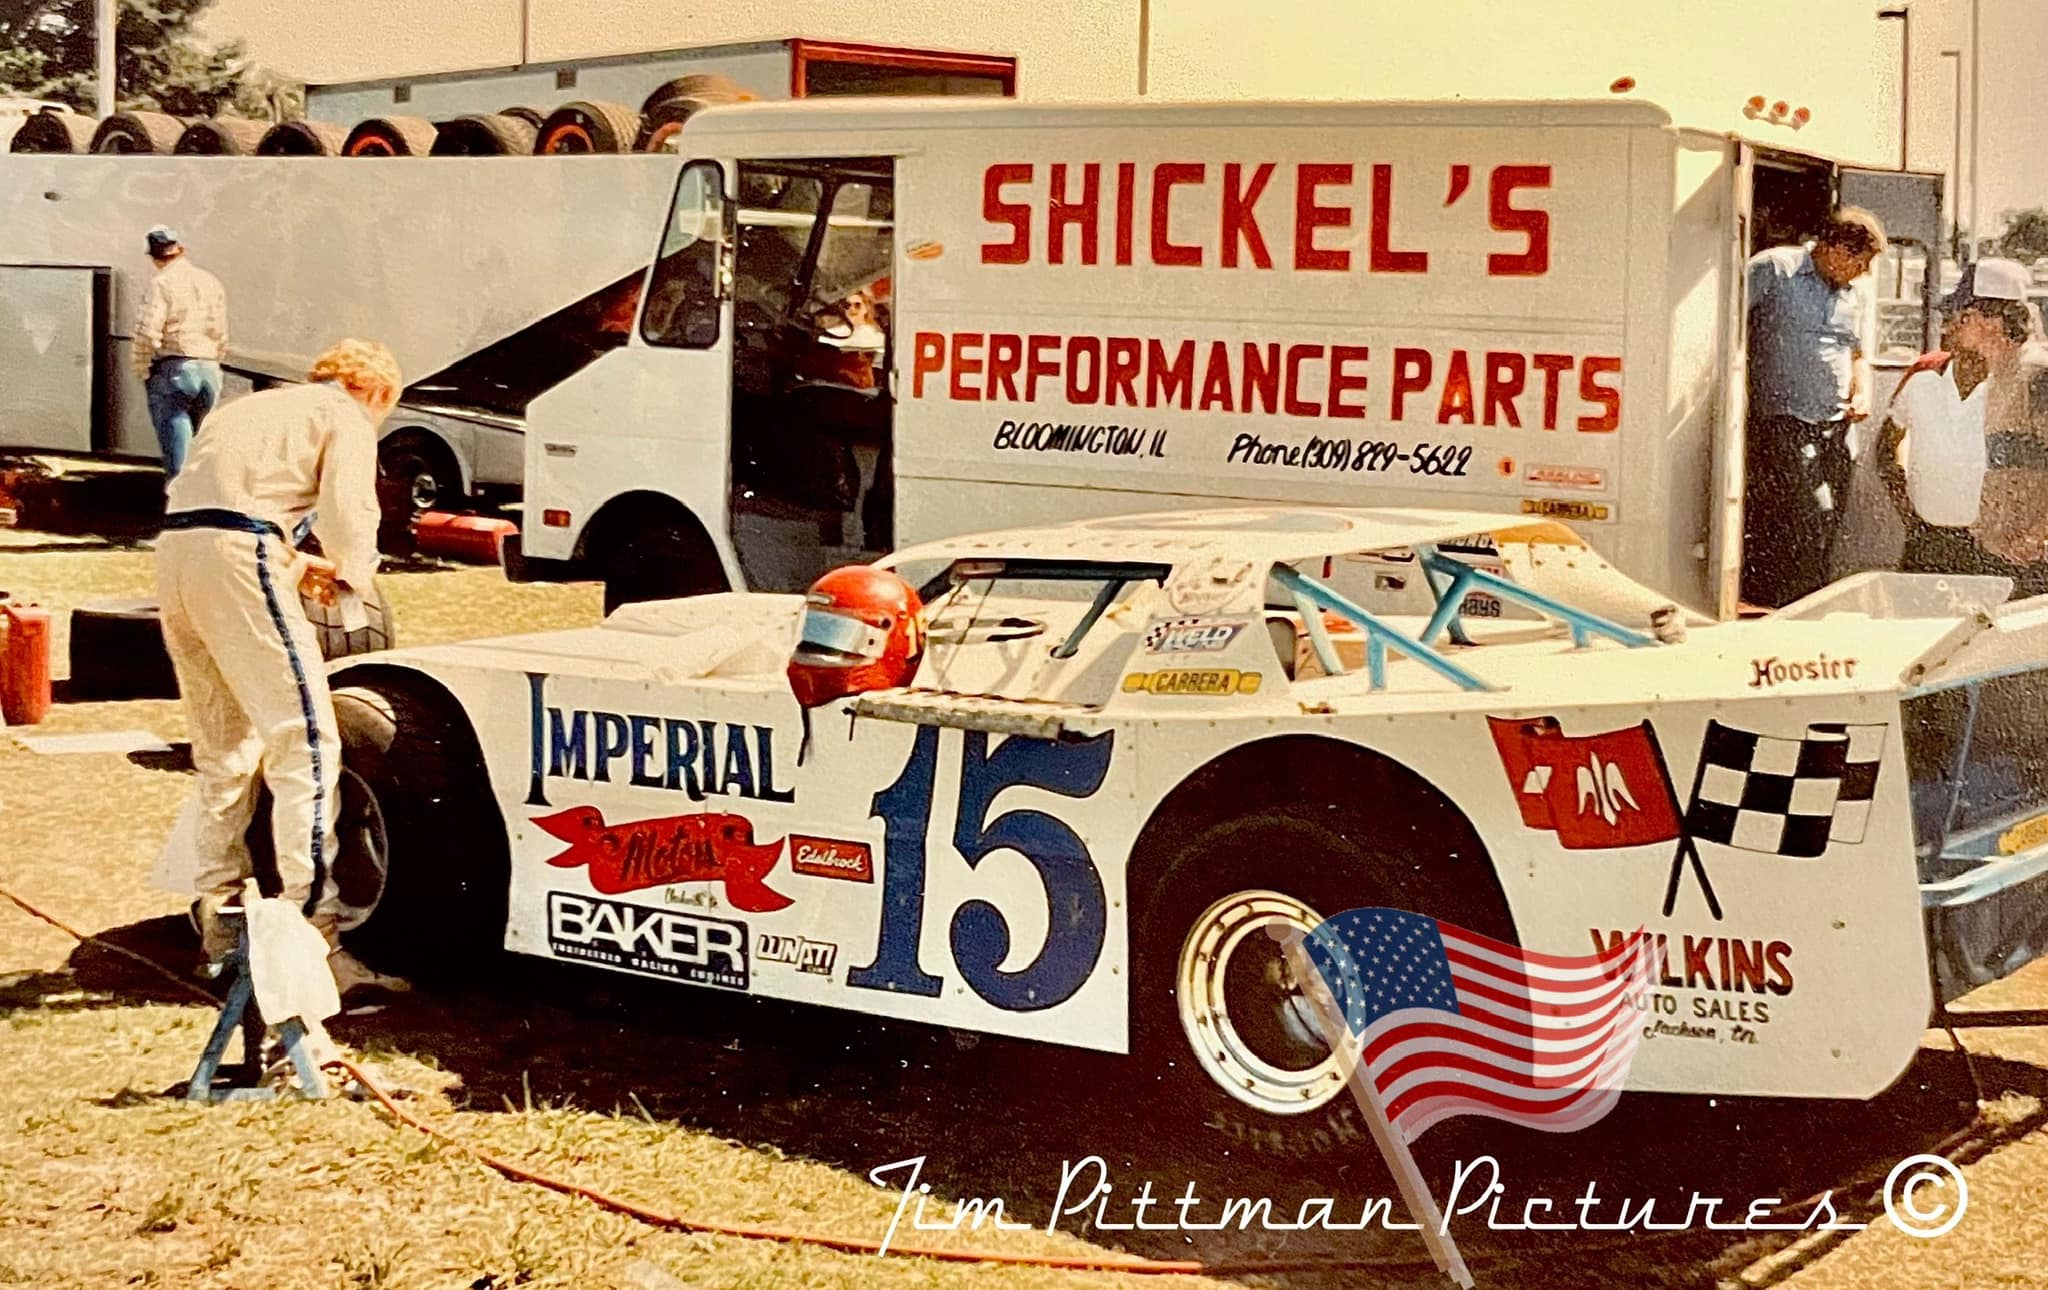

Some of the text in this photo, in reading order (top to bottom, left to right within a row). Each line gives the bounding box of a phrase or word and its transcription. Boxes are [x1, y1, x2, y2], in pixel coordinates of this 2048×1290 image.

[981, 163, 1552, 277] SHICKEL'S
[912, 332, 1622, 434] PERFORMANCE PARTS
[1227, 433, 1301, 467] Phone
[1155, 672, 1230, 693] CARRERA
[1748, 653, 1857, 688] Hoosier
[796, 844, 866, 873] Edelbrock
[846, 723, 1114, 1012] 15
[550, 894, 745, 972] BAKER
[1588, 926, 1794, 996] WILKINS
[1620, 991, 1771, 1024] AUTO SALES
